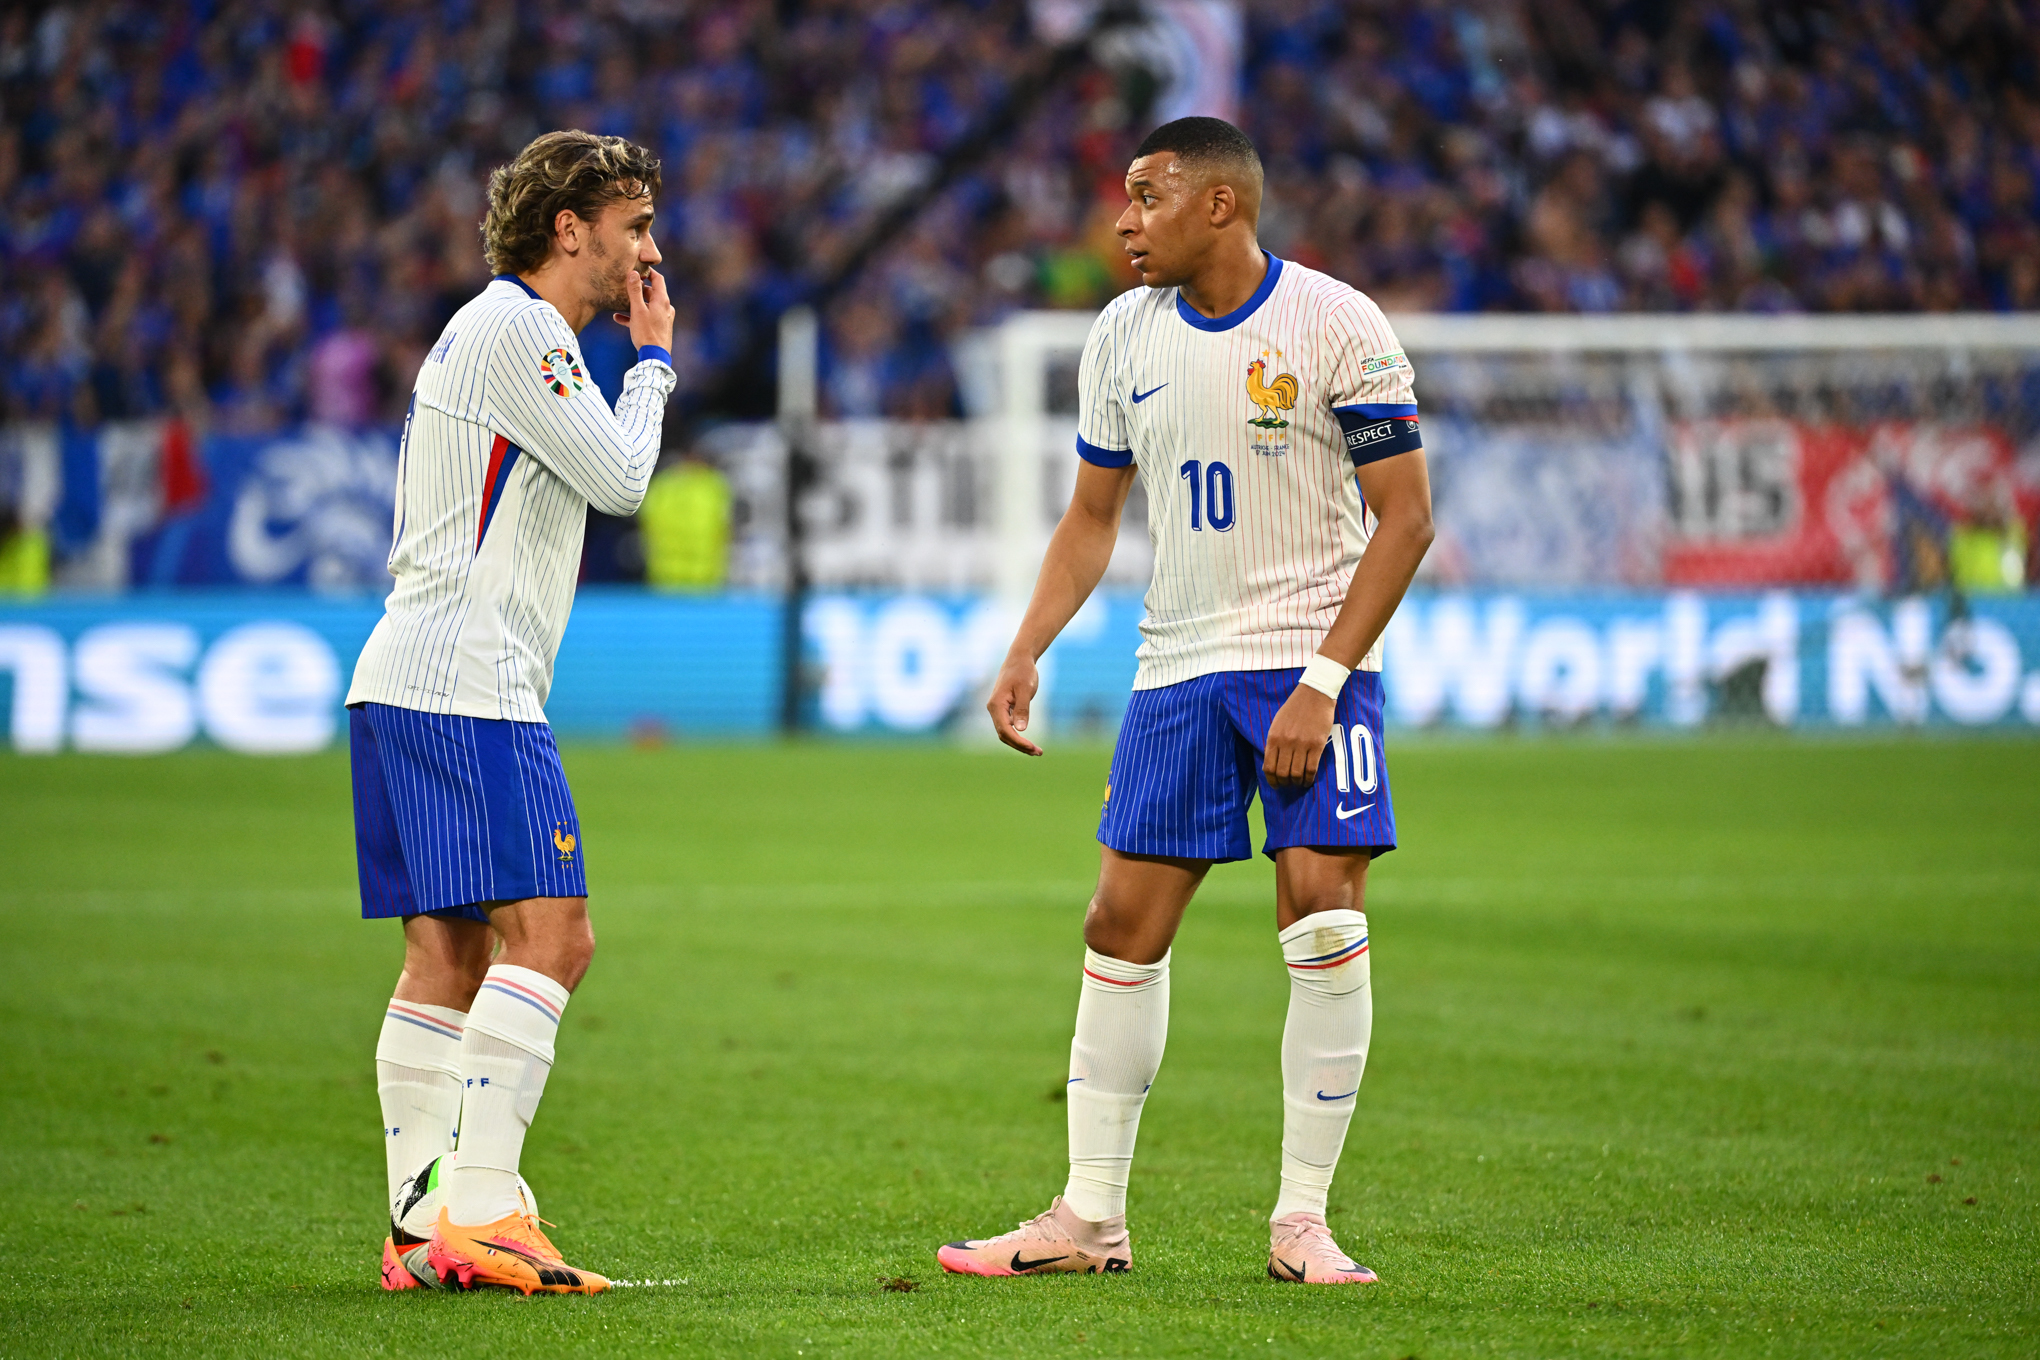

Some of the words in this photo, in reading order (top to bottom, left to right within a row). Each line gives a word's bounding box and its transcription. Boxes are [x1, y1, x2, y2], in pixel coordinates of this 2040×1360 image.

[1360, 357, 1374, 365] UEFA
[1274, 443, 1290, 451] FRANCE
[1346, 424, 1392, 446] RESPECT
[1180, 459, 1236, 532] 10
[1384, 592, 1799, 727] World
[1325, 723, 1378, 795] 10
